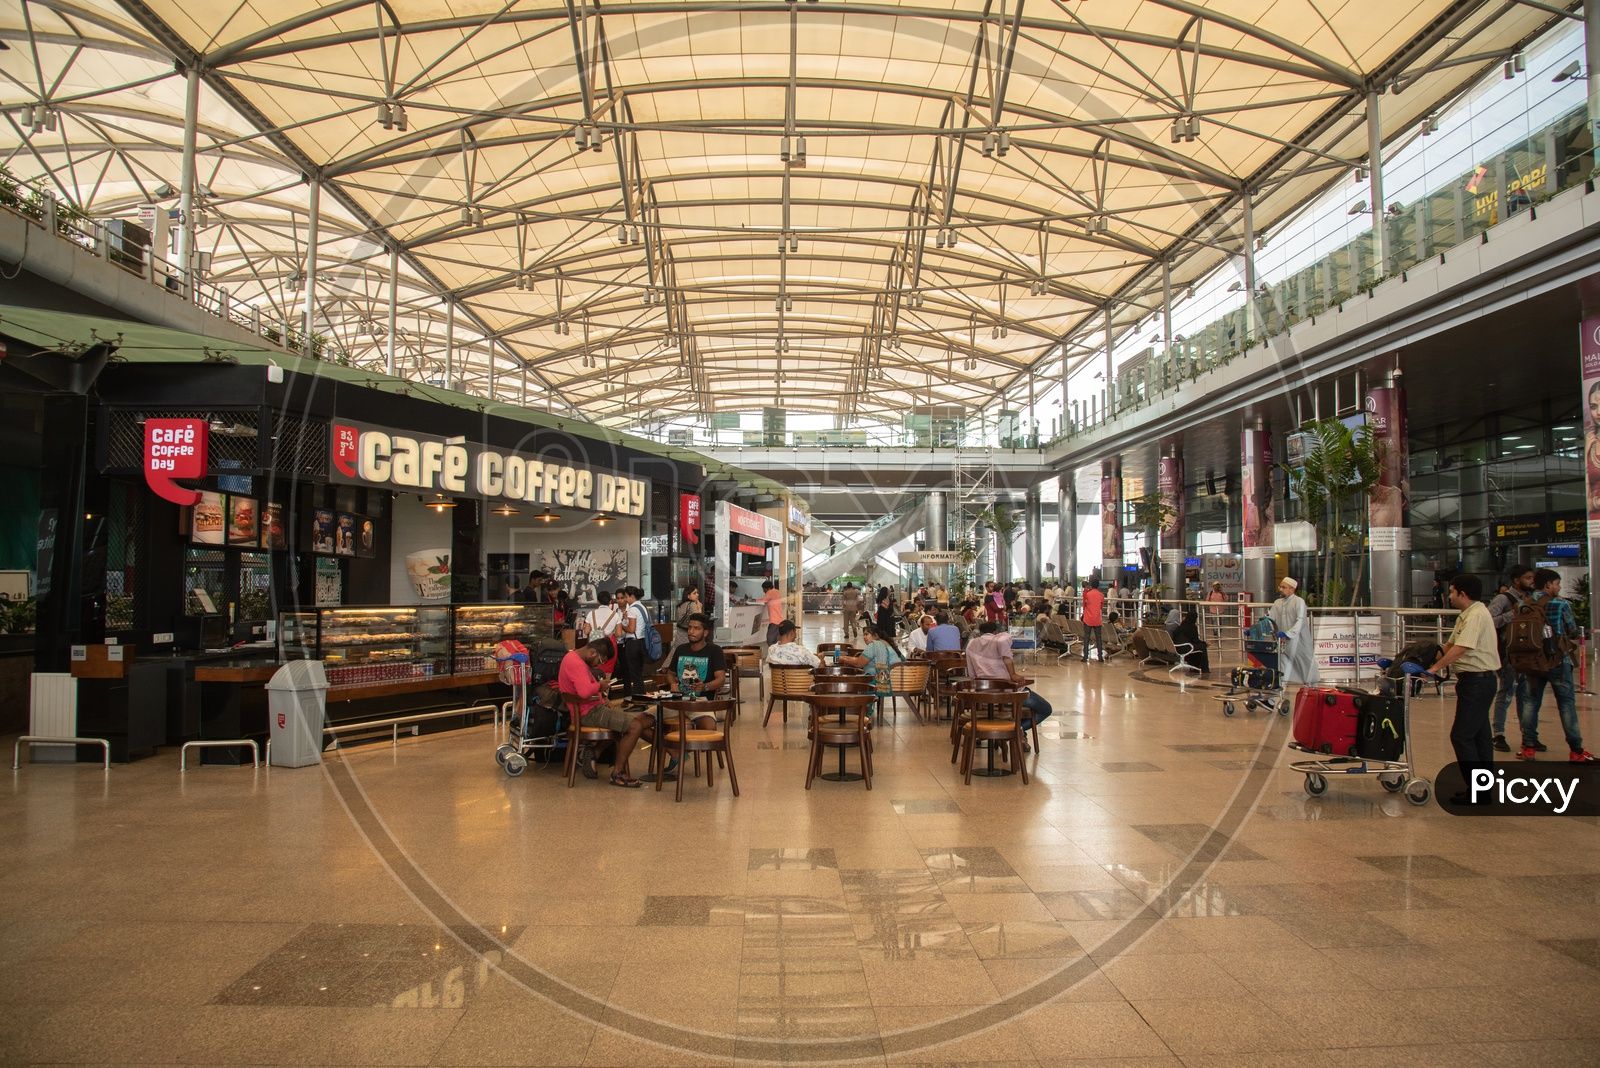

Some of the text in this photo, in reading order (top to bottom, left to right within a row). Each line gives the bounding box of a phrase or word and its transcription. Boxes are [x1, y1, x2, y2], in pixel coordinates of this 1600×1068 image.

[152, 424, 194, 443] Café
[152, 445, 194, 457] Coffee
[152, 459, 175, 471] Day
[359, 431, 468, 492] Café
[477, 452, 592, 508] Coffee
[598, 473, 645, 516] Day
